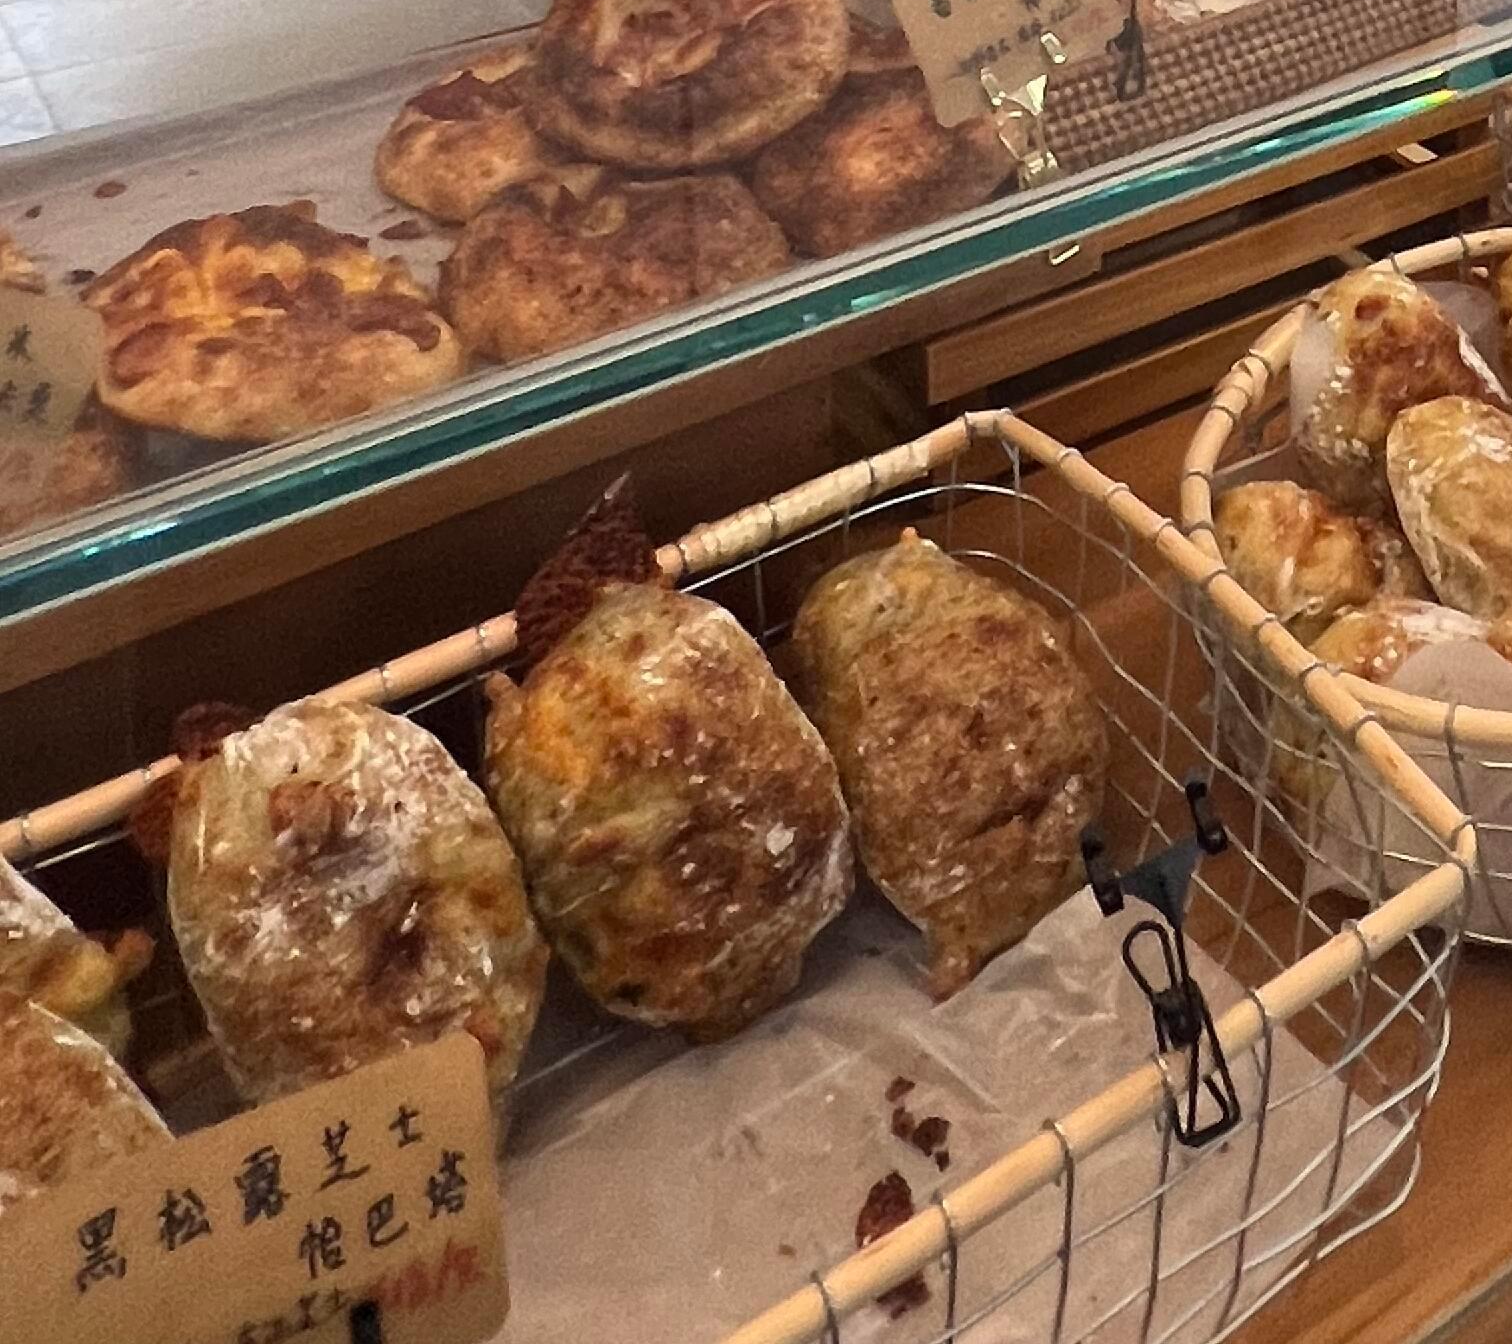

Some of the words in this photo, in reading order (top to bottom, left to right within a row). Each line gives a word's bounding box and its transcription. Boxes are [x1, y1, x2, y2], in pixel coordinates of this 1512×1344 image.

[74, 1102, 424, 1293] 黑松露芝士
